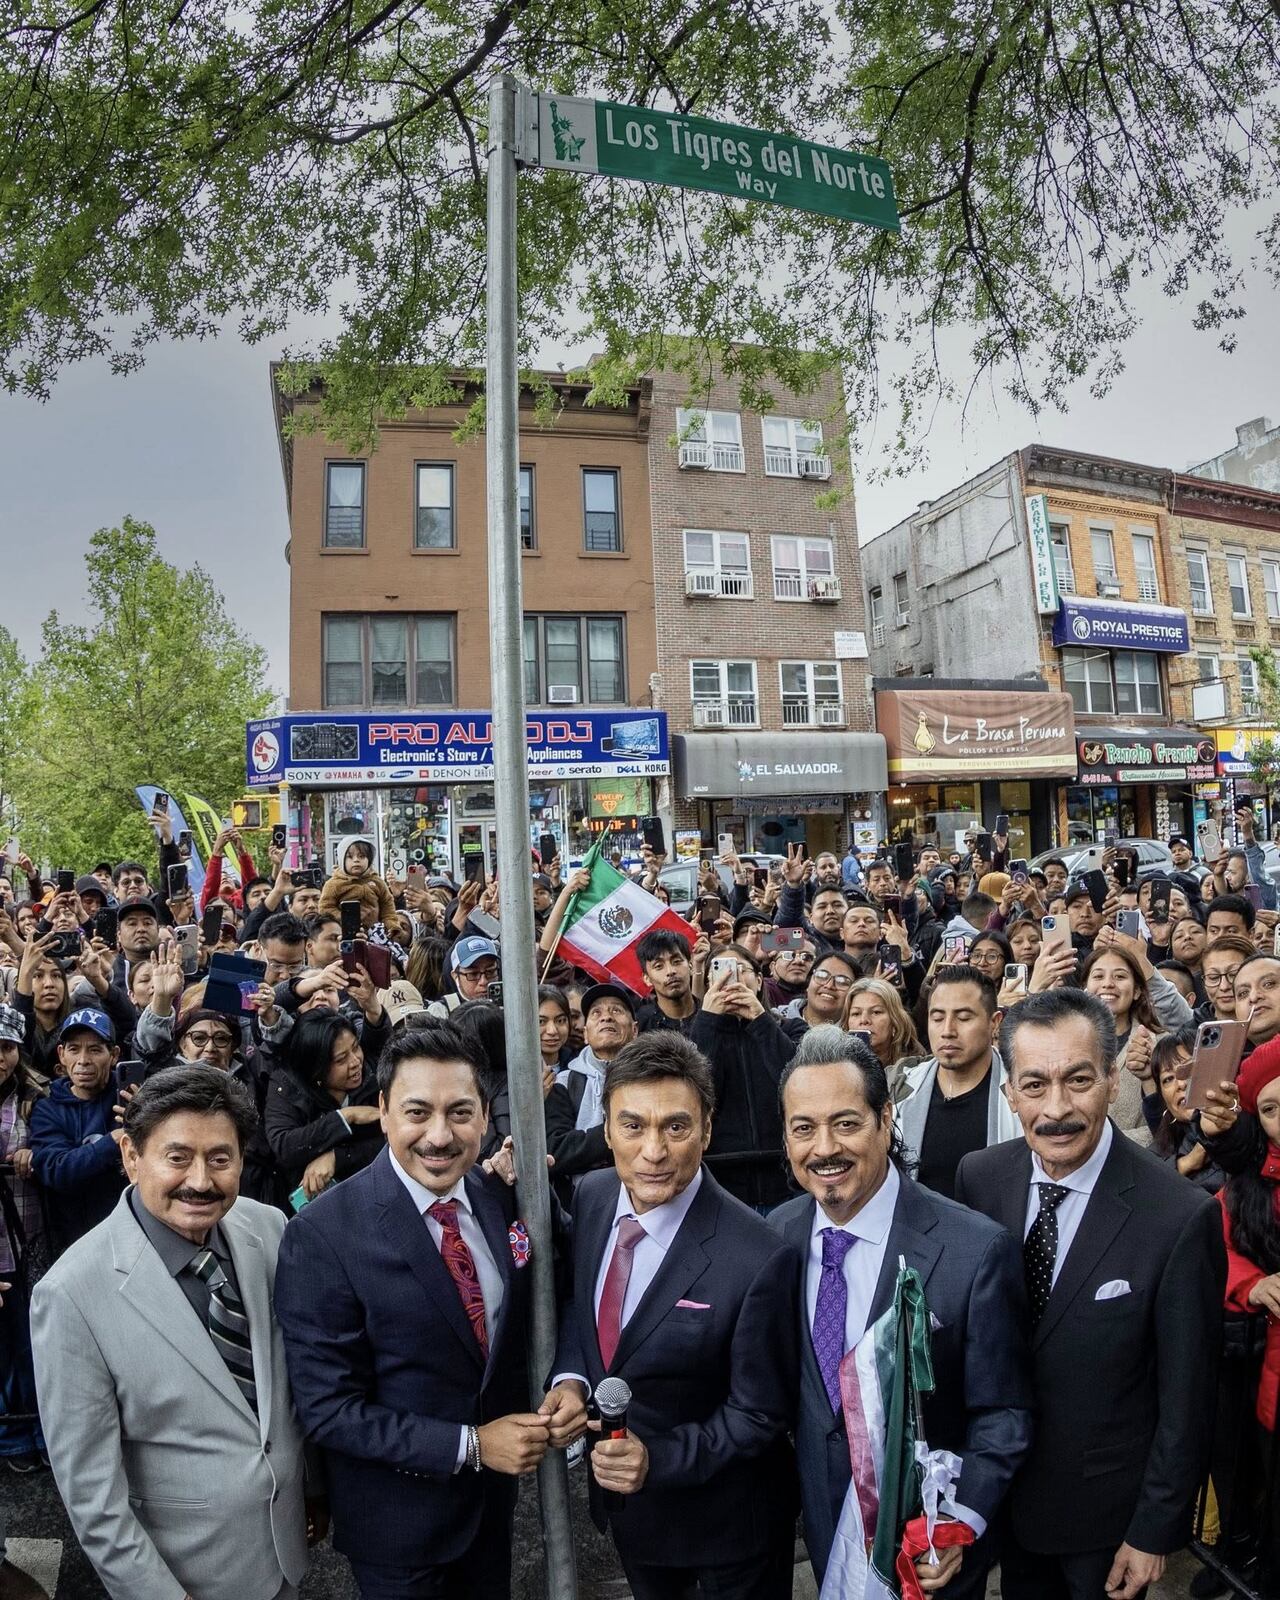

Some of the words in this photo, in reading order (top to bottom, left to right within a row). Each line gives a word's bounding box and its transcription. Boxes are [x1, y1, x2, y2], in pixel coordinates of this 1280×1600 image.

[606, 109, 659, 150] Los
[666, 119, 752, 171] Tigres
[762, 140, 802, 179] del
[811, 150, 885, 199] Norte
[736, 171, 777, 199] Way
[1092, 620, 1131, 635] ROYAL
[1132, 624, 1183, 639] PRESTIGE
[369, 723, 439, 745] PRO
[445, 722, 543, 744] AUO
[547, 721, 592, 743] DJ
[943, 715, 969, 745] La
[976, 717, 1015, 742] Brasa
[1019, 716, 1066, 744] Peruana
[380, 748, 445, 763] Electronic's
[447, 748, 478, 762] Store
[527, 747, 583, 763] Appliances
[959, 747, 987, 755] POLLOS
[1103, 743, 1153, 764] Rancho
[1154, 743, 1199, 764] Grande
[287, 771, 320, 781] SONY
[333, 771, 362, 779] YAMAHA
[433, 769, 471, 778] DENON
[569, 765, 602, 774] serato
[617, 765, 641, 773] DELL
[645, 764, 666, 773] KORG
[756, 764, 772, 775] EL
[775, 763, 837, 775] SALVADOR
[69, 1010, 102, 1026] NY
